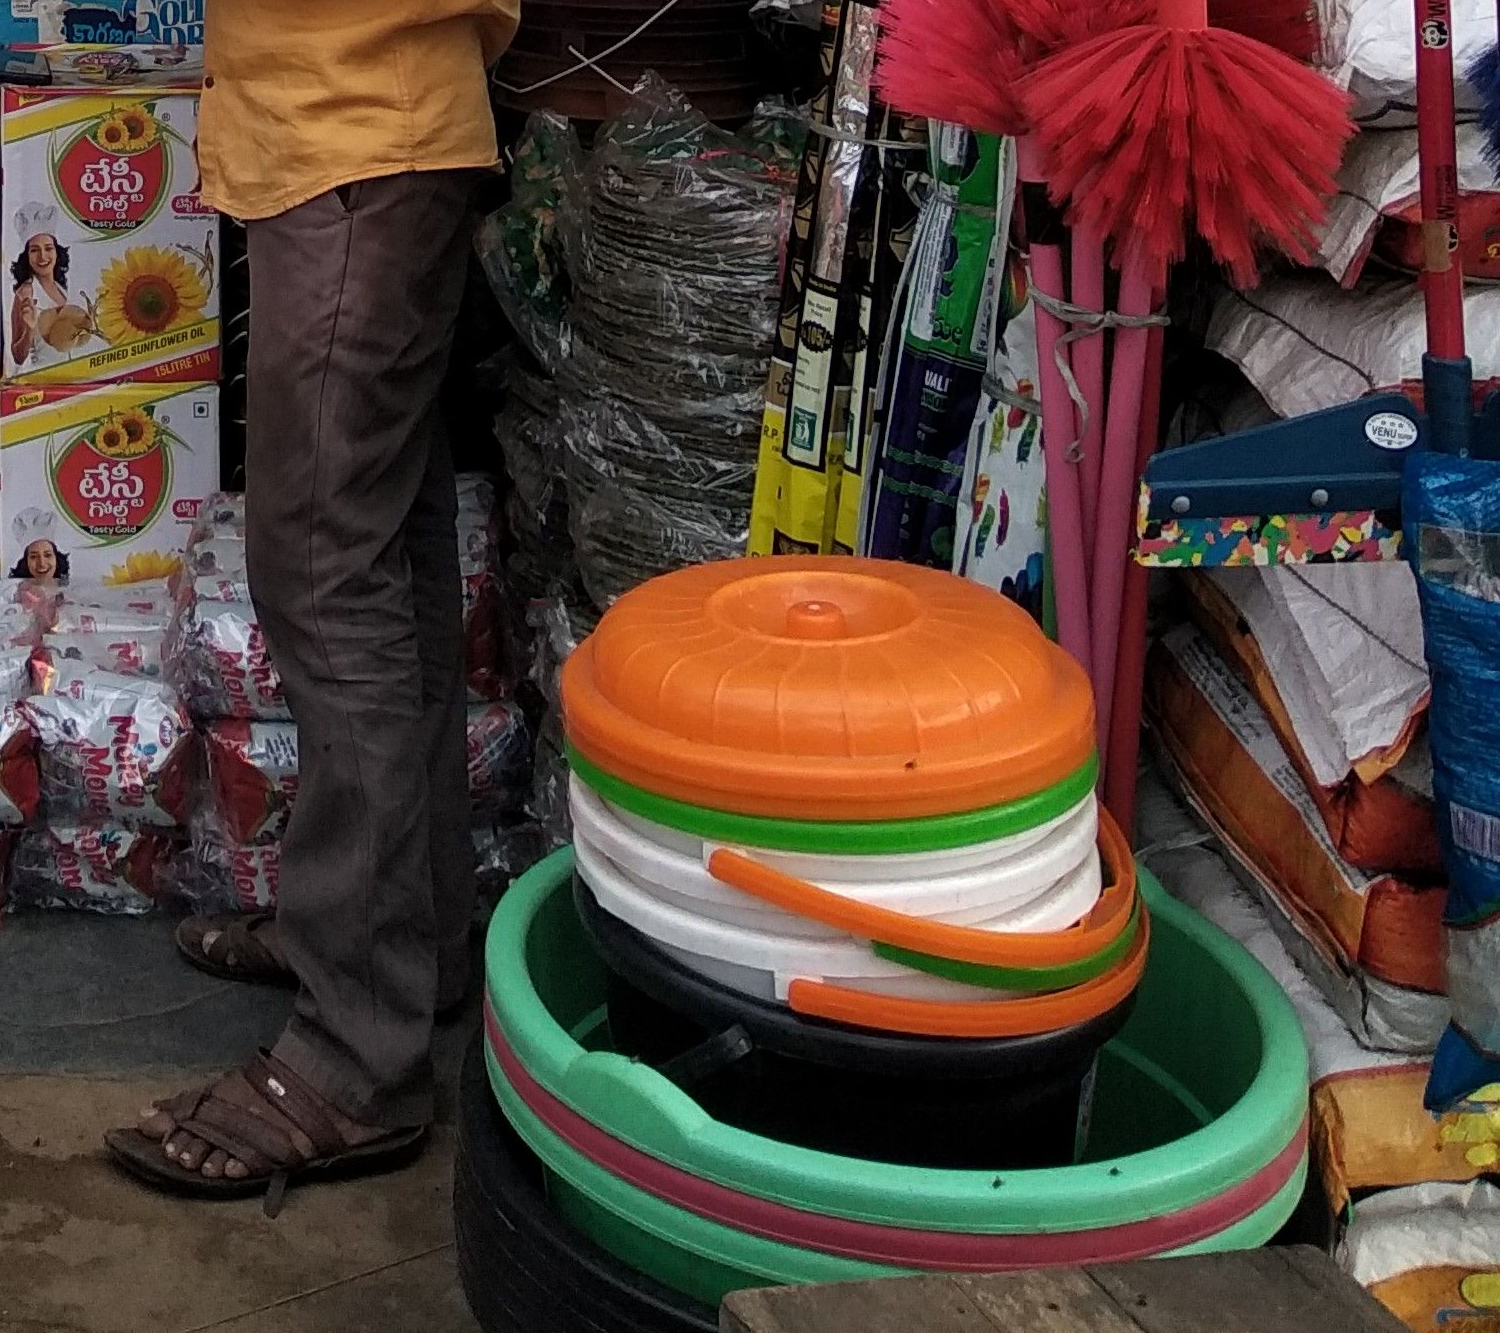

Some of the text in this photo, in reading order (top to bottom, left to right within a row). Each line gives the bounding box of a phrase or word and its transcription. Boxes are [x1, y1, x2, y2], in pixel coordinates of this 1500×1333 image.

[80, 156, 144, 203] టేస్టీ
[88, 326, 206, 369] REFINED SUNFLOWER OIL
[1371, 425, 1398, 439] VENU
[78, 460, 145, 507] టేస్టీ
